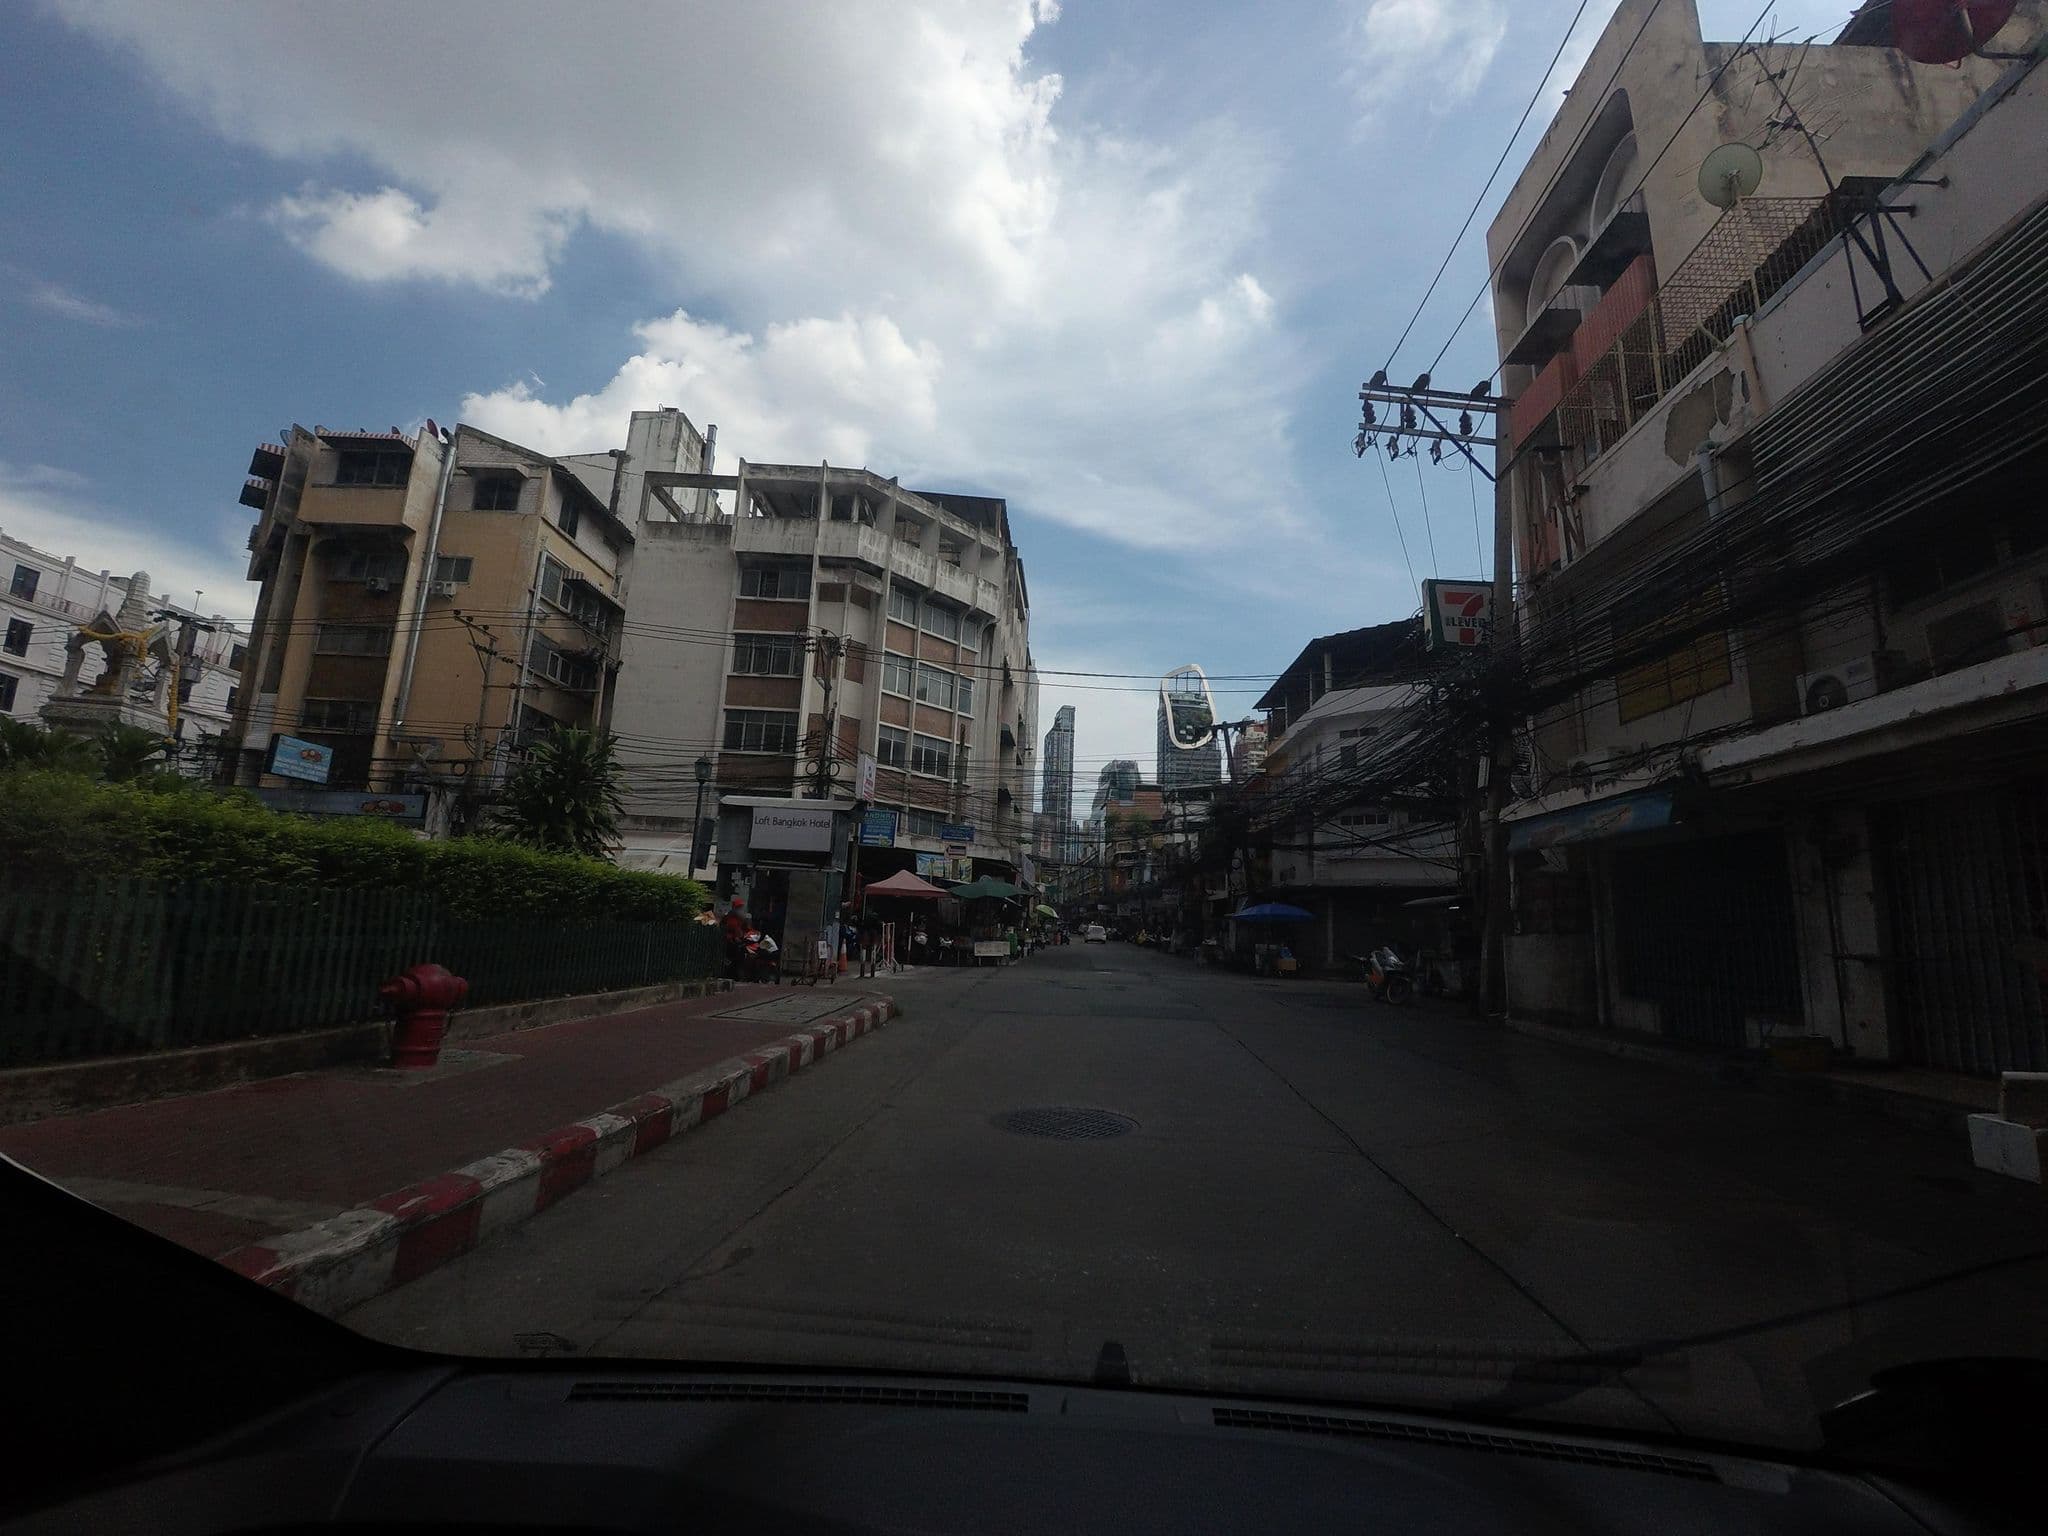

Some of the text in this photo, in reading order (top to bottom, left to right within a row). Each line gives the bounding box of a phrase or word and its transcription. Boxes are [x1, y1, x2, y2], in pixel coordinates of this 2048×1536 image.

[1445, 592, 1484, 644] 7
[754, 816, 831, 829] Loft Bangkok Hotel
